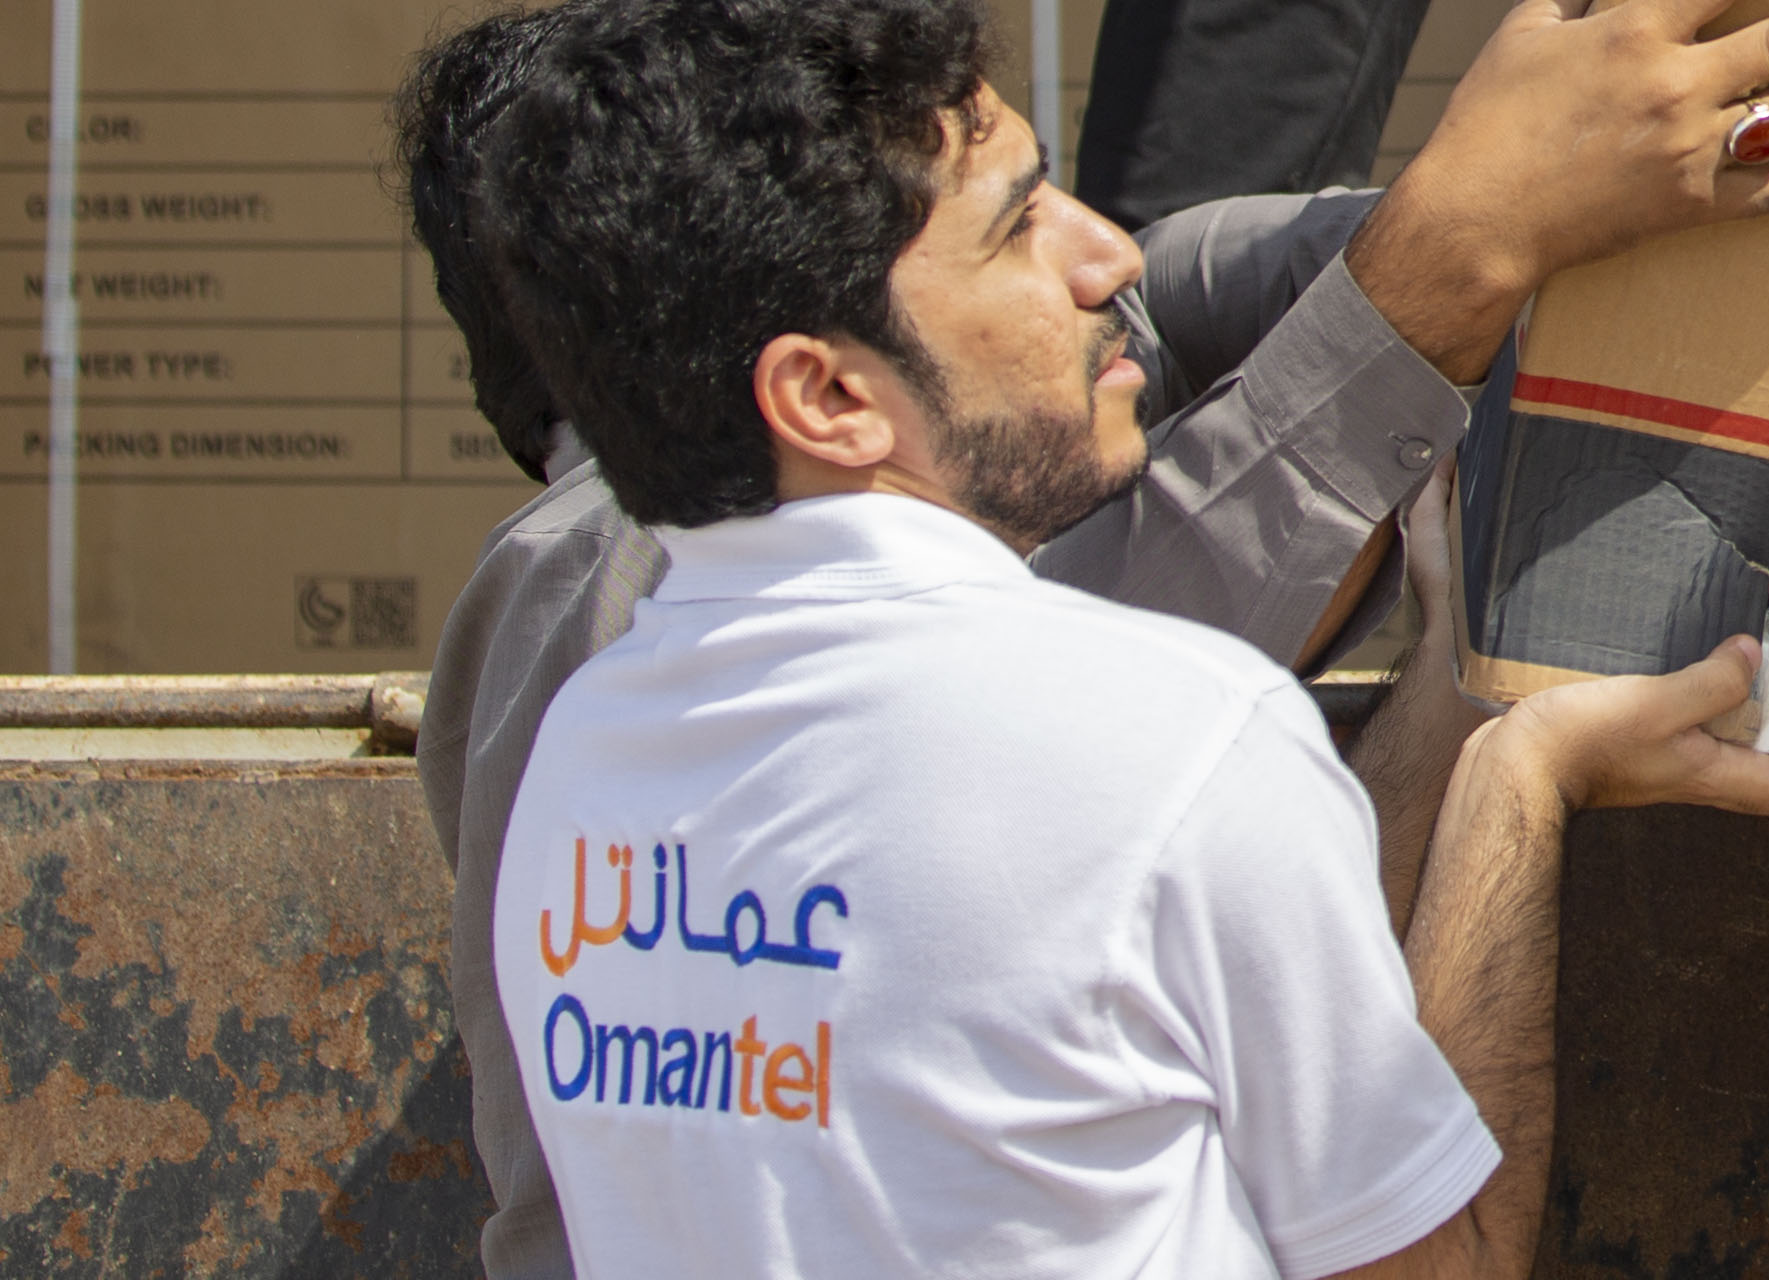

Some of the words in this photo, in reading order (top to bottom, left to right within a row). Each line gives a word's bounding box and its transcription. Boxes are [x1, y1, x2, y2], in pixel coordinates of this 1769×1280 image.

[25, 193, 133, 224] GOSS
[169, 430, 352, 463] DIMENSION:
[539, 837, 849, 978] عمانتل
[543, 993, 831, 1130] Omantel
